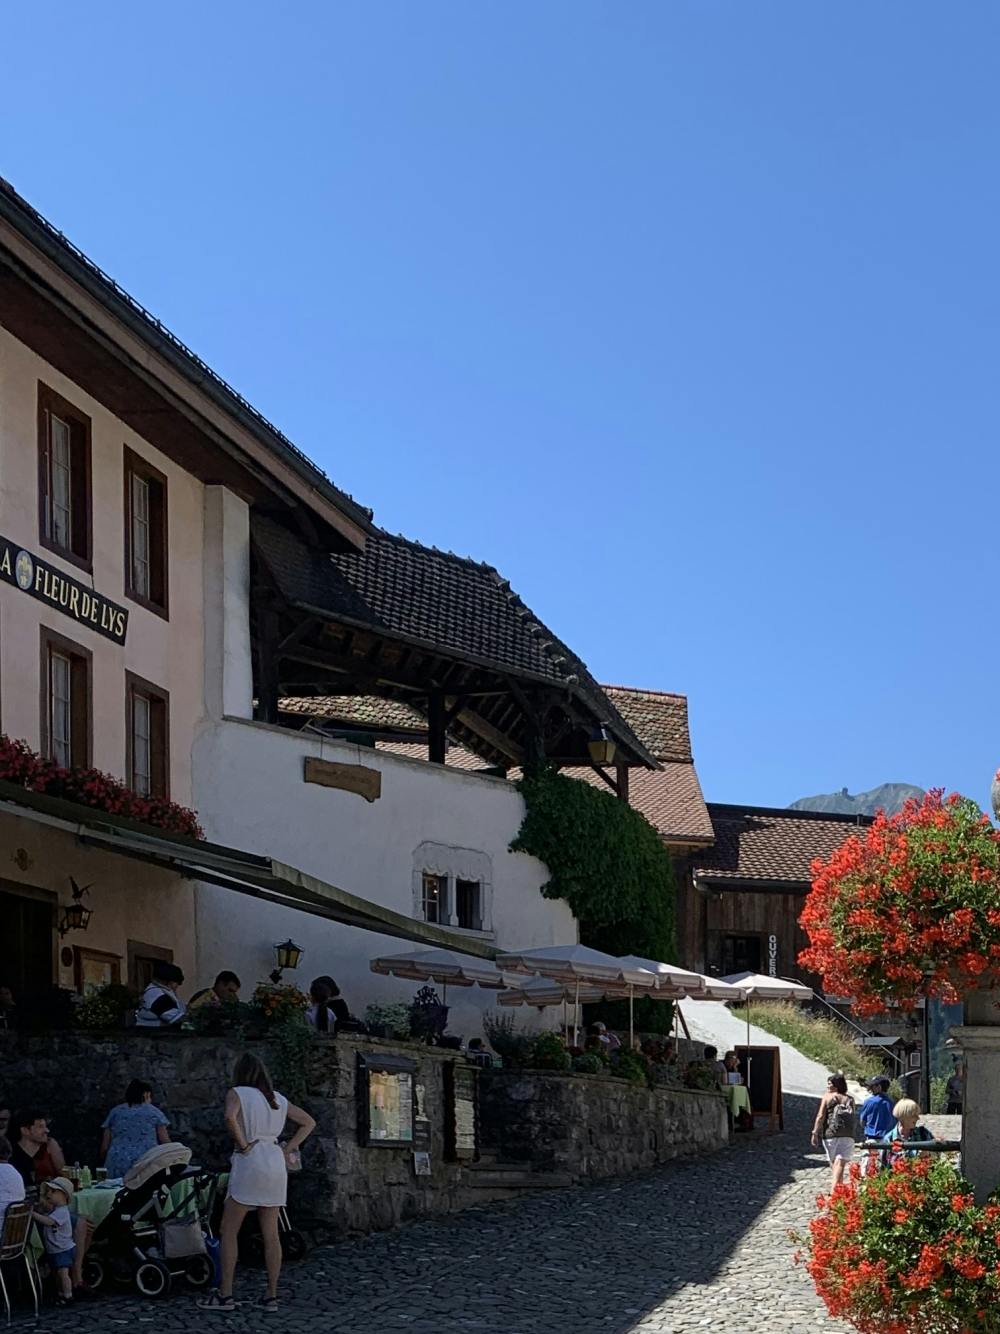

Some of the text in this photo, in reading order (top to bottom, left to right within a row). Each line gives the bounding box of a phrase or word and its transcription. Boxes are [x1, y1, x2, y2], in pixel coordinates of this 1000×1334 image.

[34, 565, 80, 618] FLEUR
[81, 592, 99, 622] DE
[101, 604, 125, 637] LYS
[768, 934, 777, 977] OUVER
